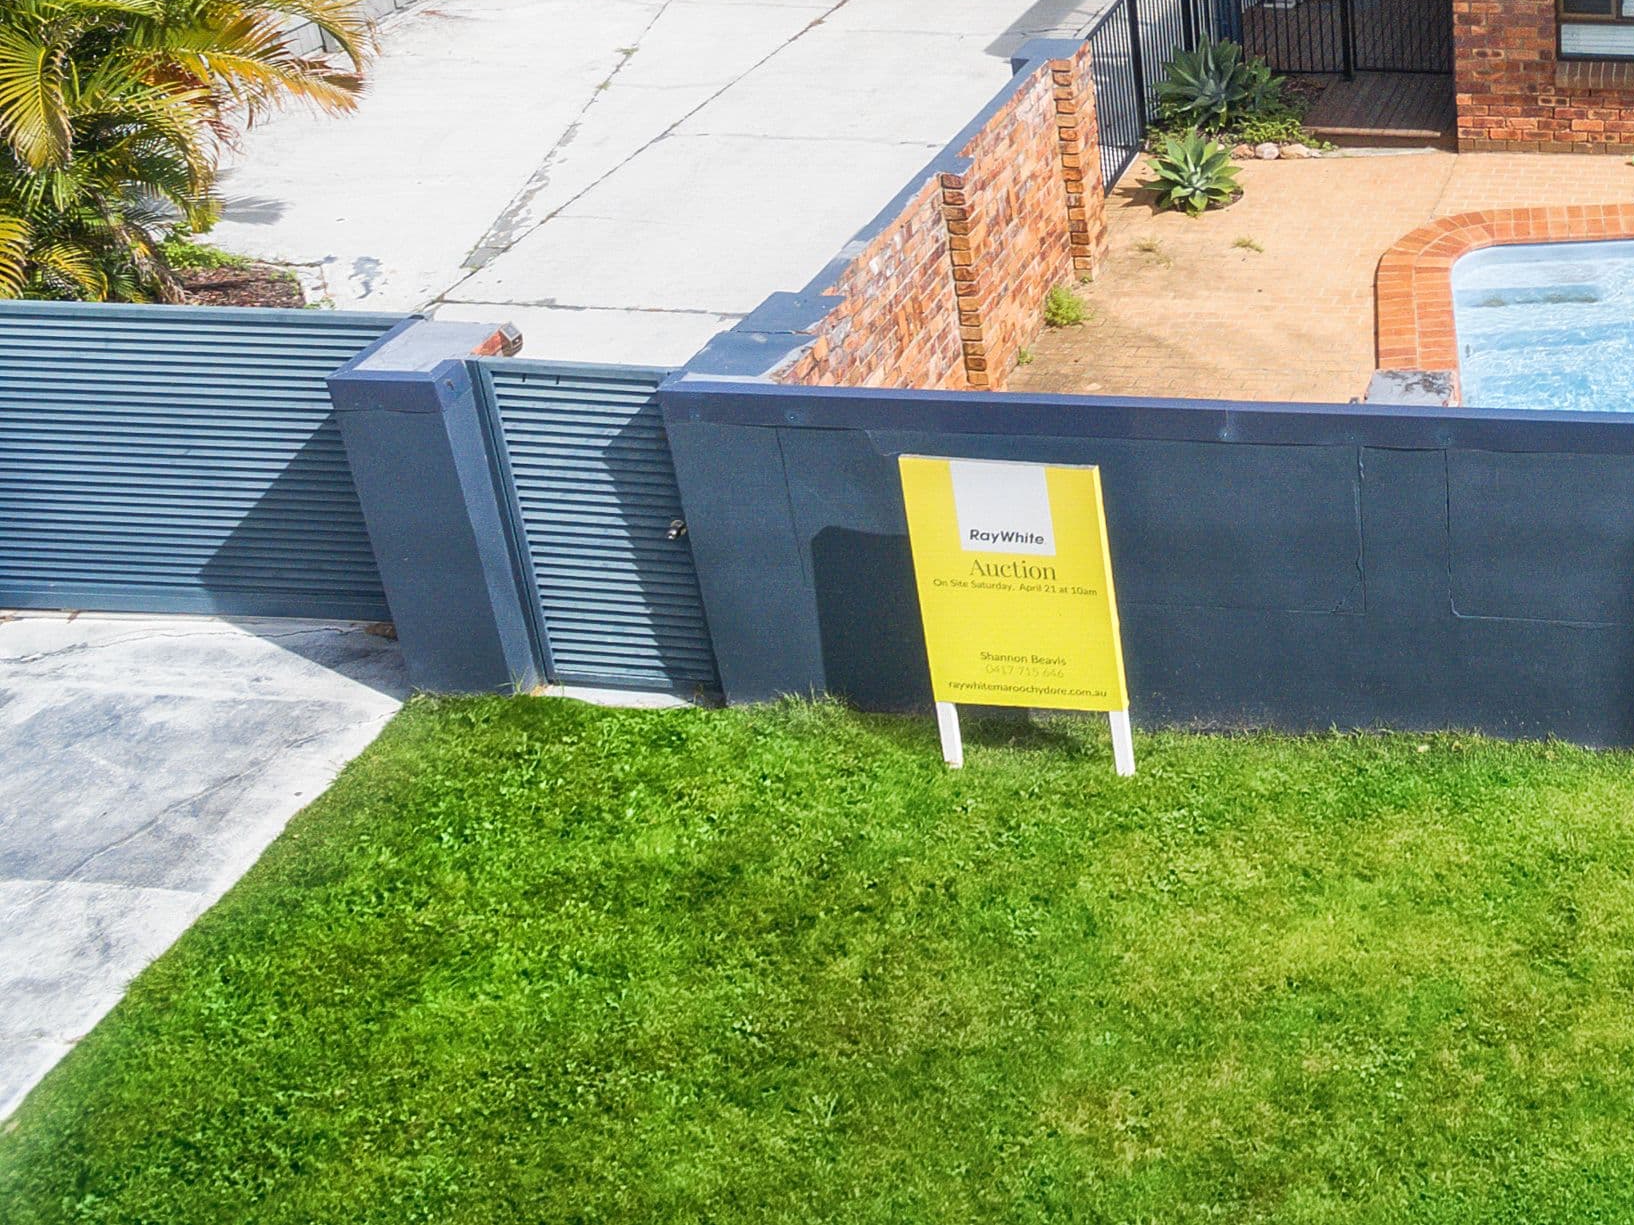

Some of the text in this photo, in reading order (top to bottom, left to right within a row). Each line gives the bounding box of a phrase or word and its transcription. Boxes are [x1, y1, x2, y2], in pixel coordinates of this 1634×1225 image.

[969, 559, 1057, 581] Auction
[933, 578, 1097, 596] On Site Saturday, April 21 at 10am
[979, 651, 1028, 664] Shannon
